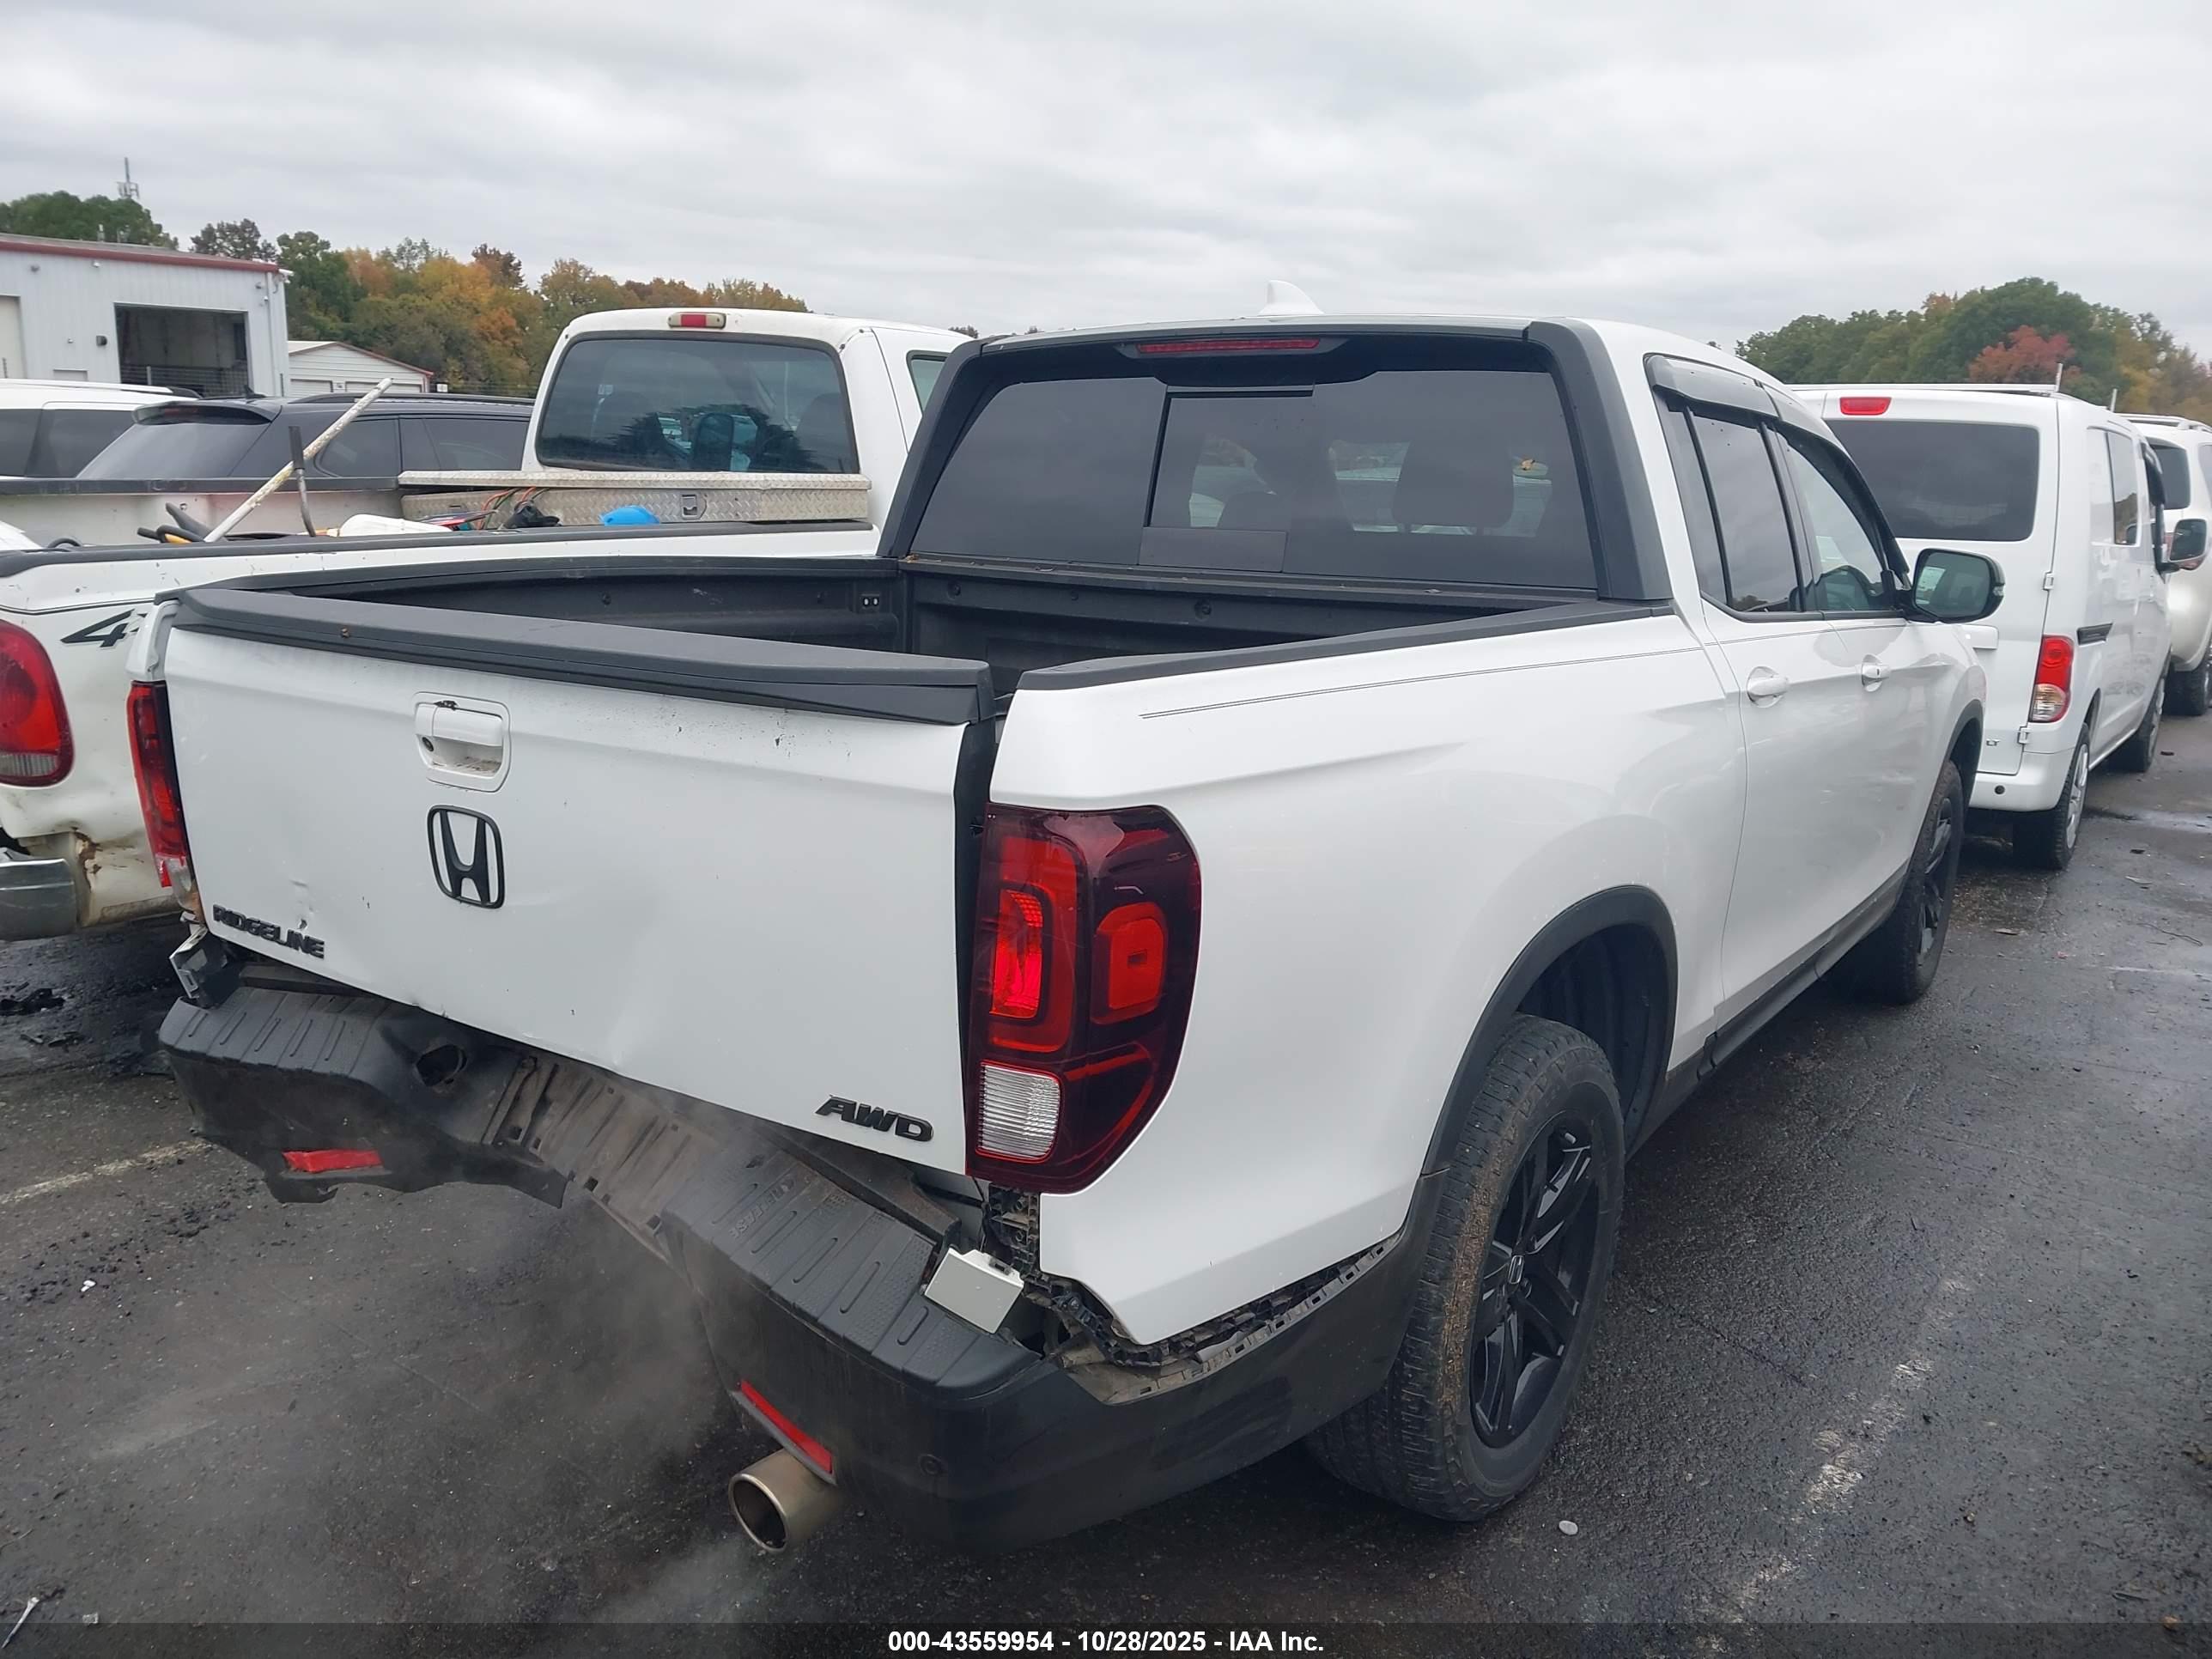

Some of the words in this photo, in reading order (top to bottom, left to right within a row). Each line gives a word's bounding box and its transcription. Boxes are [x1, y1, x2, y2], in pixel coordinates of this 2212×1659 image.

[60, 608, 148, 647] 4
[213, 904, 325, 959] RIDGELINE
[815, 1094, 934, 1142] AWD
